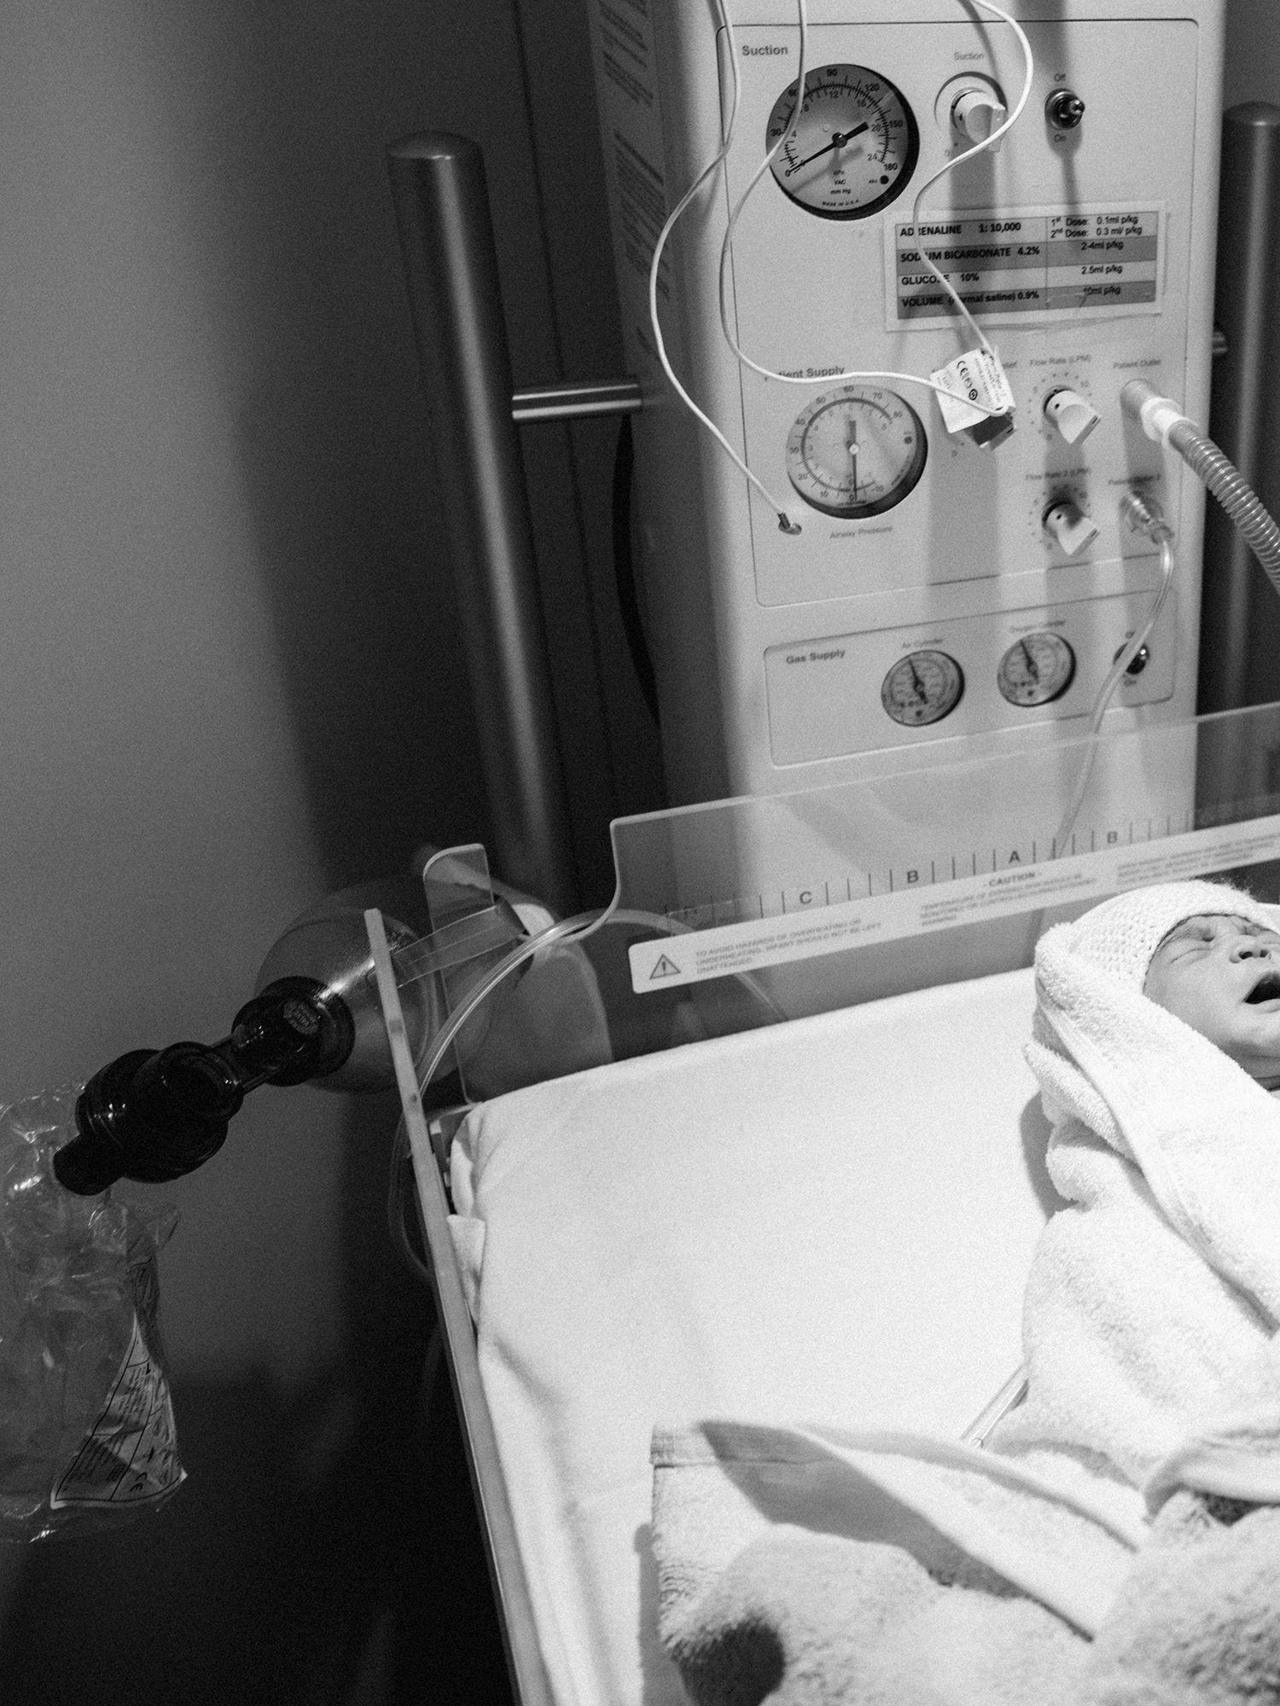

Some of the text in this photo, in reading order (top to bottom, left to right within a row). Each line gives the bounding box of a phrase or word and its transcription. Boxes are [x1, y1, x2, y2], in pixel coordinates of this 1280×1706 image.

[742, 45, 789, 57] Suction
[864, 83, 881, 94] 120
[829, 90, 839, 98] 12
[770, 128, 782, 137] 30
[791, 130, 797, 138] 4
[867, 154, 878, 162] 24
[883, 163, 898, 171] 180
[1121, 215, 1139, 225] p/kg
[990, 222, 1021, 233] 10,000
[1096, 227, 1109, 236] 0.3
[1106, 240, 1124, 250] p/kg
[944, 247, 1011, 260] BICARBONATE
[1017, 246, 1040, 256] 4.2%
[1105, 264, 1123, 274] p/kg
[901, 272, 980, 286] GLUCOE 10%
[1104, 285, 1121, 295] p/kg
[902, 295, 945, 308] VOLUME
[1017, 290, 1039, 300] 0.9%
[807, 365, 845, 377] Supply
[786, 649, 846, 664] Gas Supply
[800, 831, 1118, 904] C B A B
